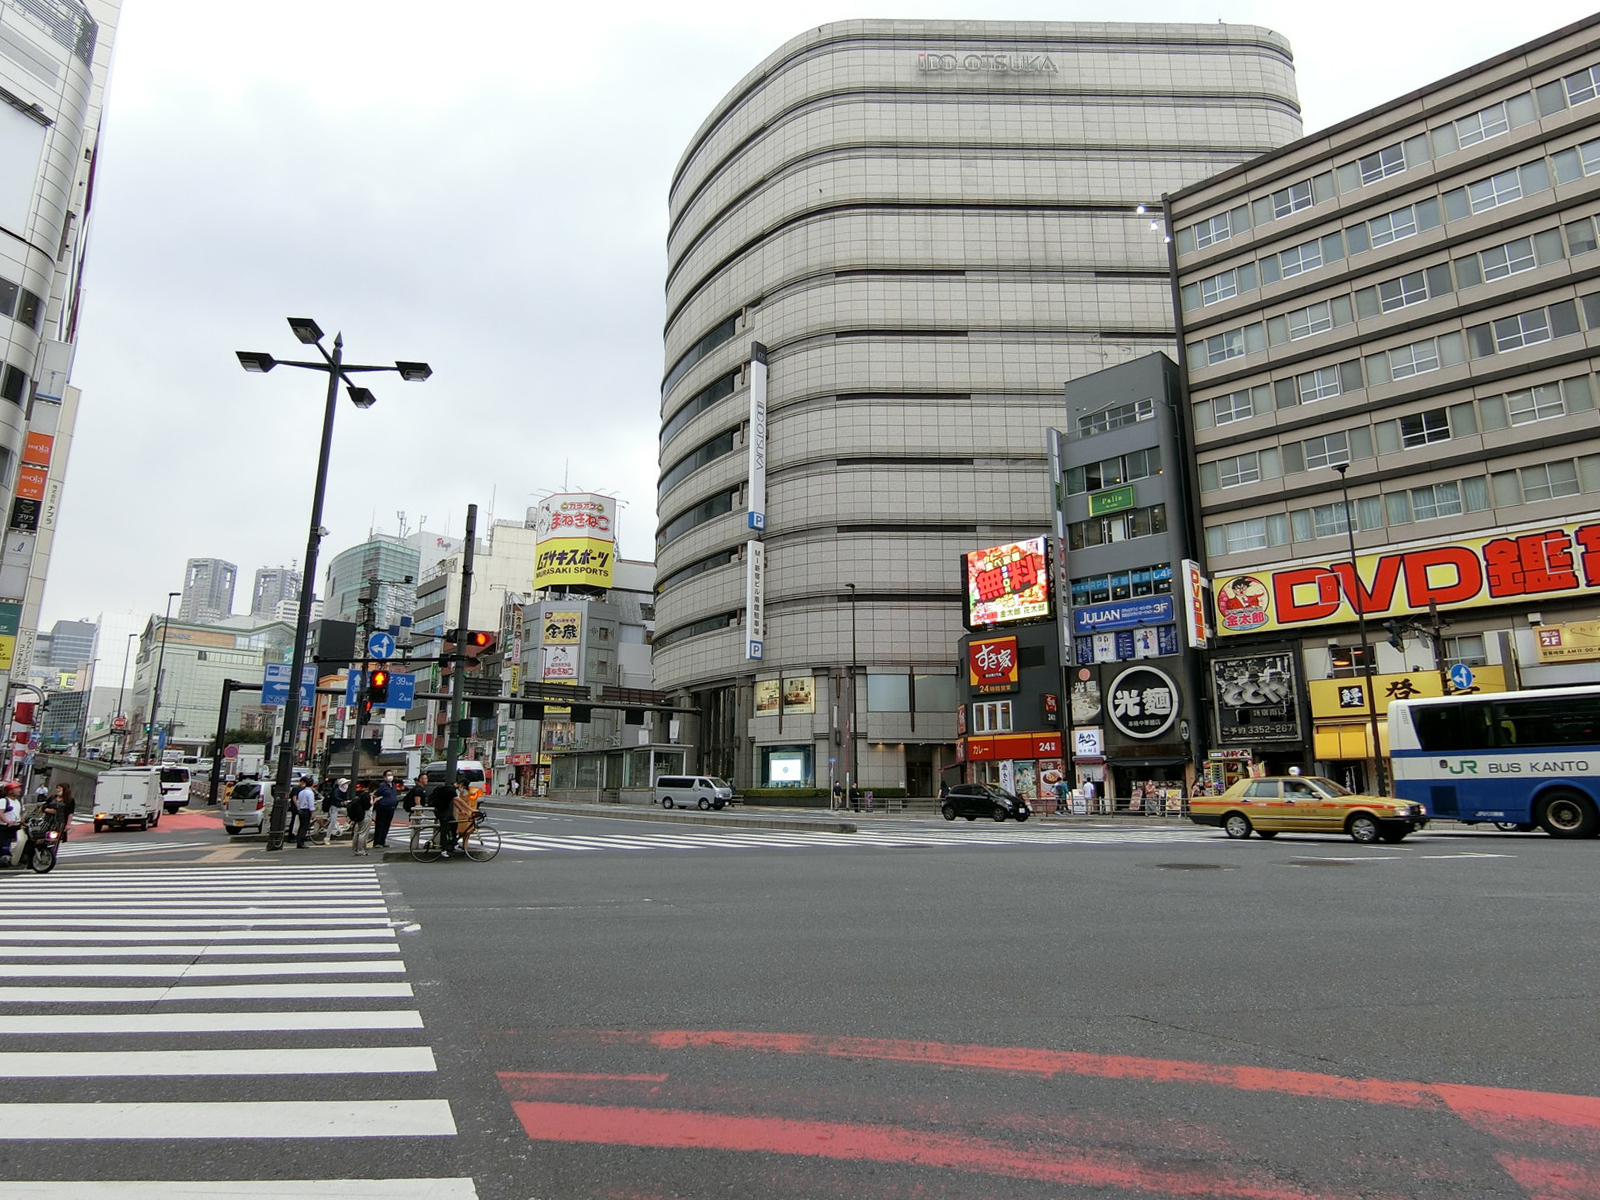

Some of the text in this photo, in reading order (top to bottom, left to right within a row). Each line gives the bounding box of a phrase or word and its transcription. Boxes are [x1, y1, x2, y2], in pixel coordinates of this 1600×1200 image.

[963, 54, 1058, 73] OTSUKA
[755, 425, 765, 471] OTSUKA
[569, 502, 597, 510] カラオケ
[550, 512, 610, 531] まねきねこ
[754, 517, 762, 527] P
[537, 548, 609, 571] ムラサキスポーツ
[536, 566, 608, 578] MURASAKI SPORTS
[975, 553, 1037, 602] 無料
[1272, 524, 1600, 625] DVD鑑
[1080, 608, 1120, 625] JULIAN
[1153, 602, 1169, 613] 3F
[1226, 611, 1265, 627] 金太郎
[1541, 637, 1559, 646] 2F
[974, 644, 1012, 672] すき家
[972, 744, 990, 755] カレー
[1449, 760, 1590, 775] JR BUS KANTO
